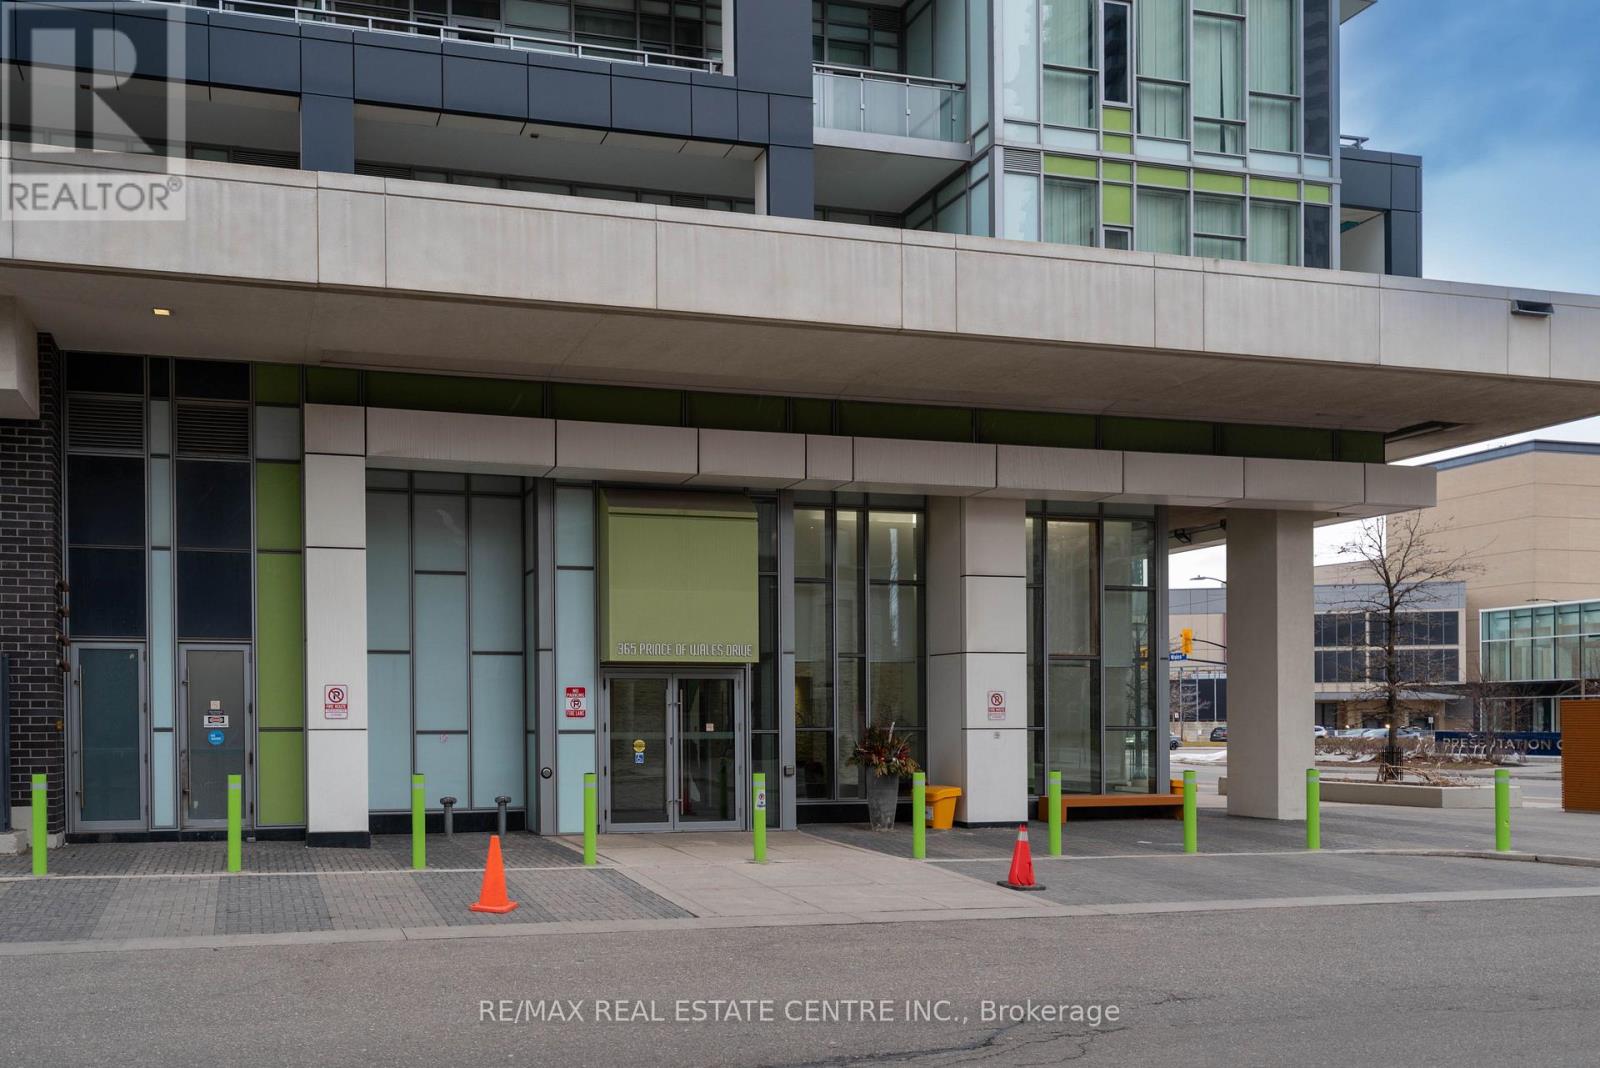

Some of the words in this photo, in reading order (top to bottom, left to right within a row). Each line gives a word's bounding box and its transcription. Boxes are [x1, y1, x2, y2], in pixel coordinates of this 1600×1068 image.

[617, 642, 637, 656] 365
[639, 642, 672, 656] PRINCE
[675, 643, 687, 656] OF
[689, 643, 723, 657] WALES
[725, 643, 753, 658] DRIVE
[1442, 737, 1551, 750] PRESETATION
